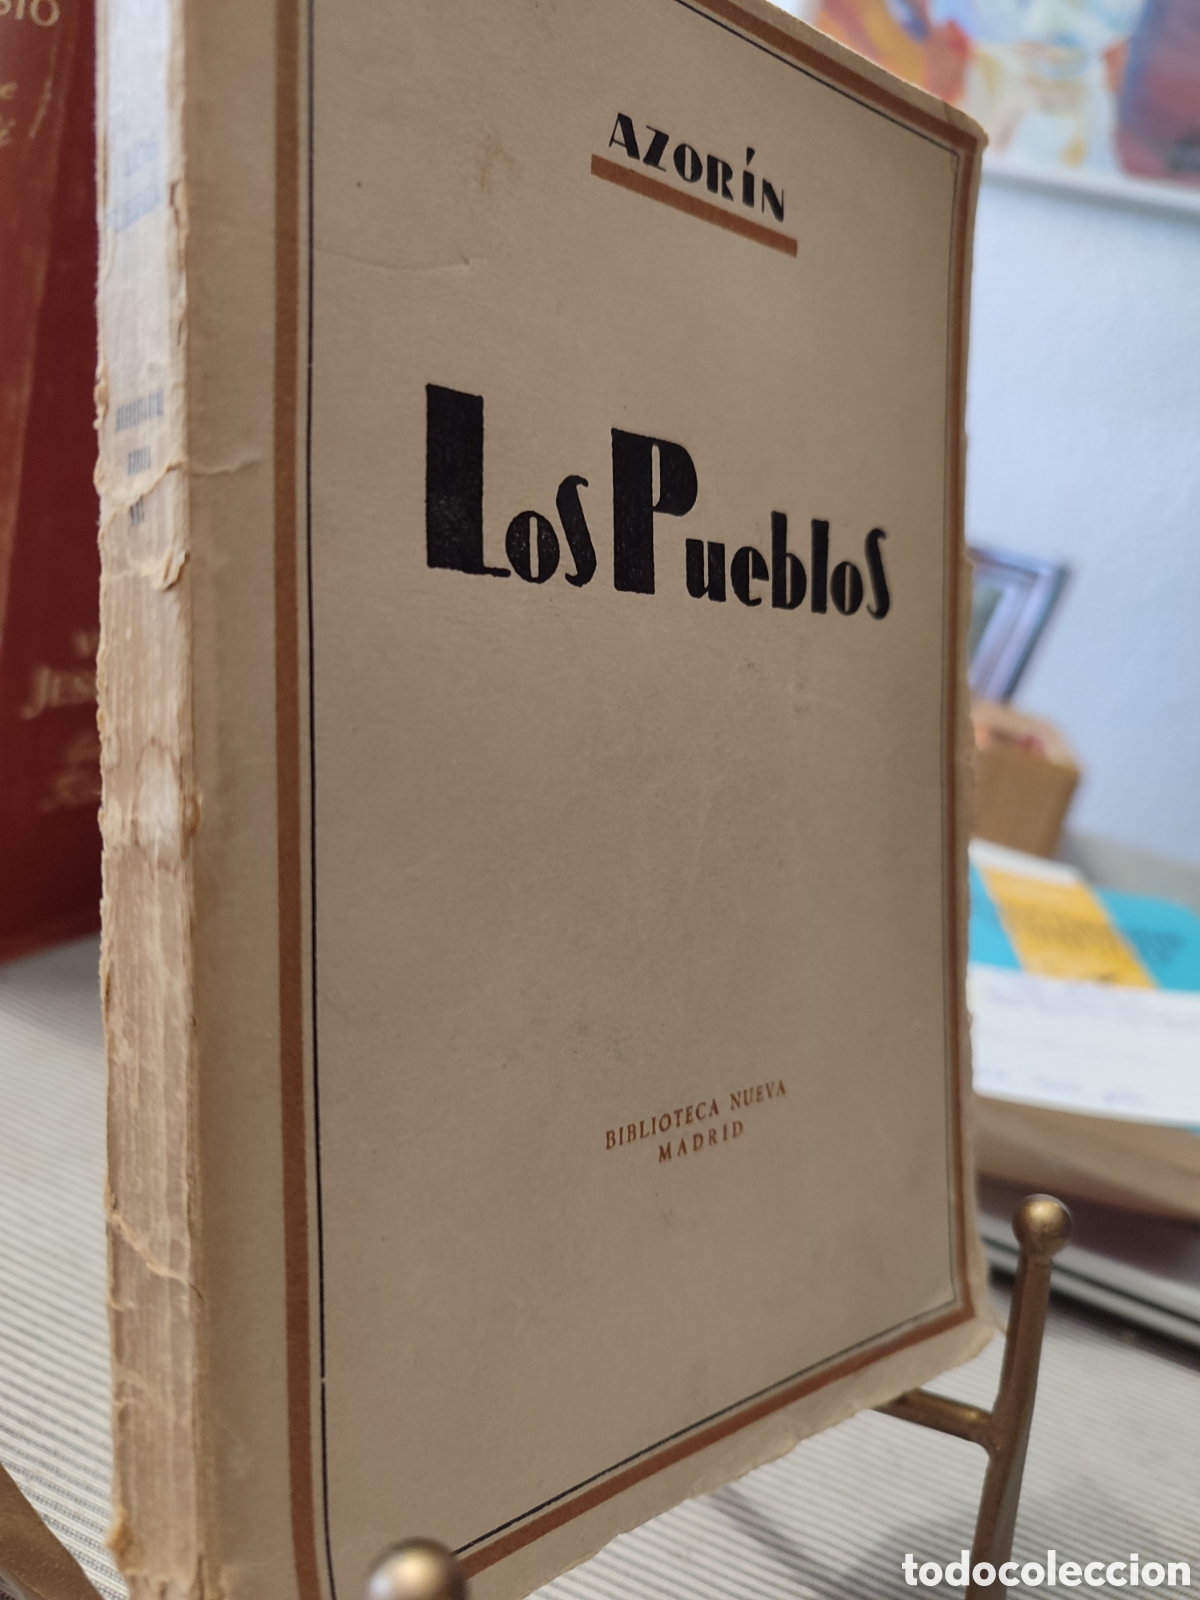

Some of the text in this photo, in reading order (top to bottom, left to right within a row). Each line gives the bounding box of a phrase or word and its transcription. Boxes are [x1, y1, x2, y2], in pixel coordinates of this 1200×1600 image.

[608, 112, 785, 223] AZORÍN
[426, 383, 890, 620] Los Pueblos
[605, 1079, 787, 1150] BIBLIOTECA NUEVA
[658, 1120, 744, 1163] MADRID
